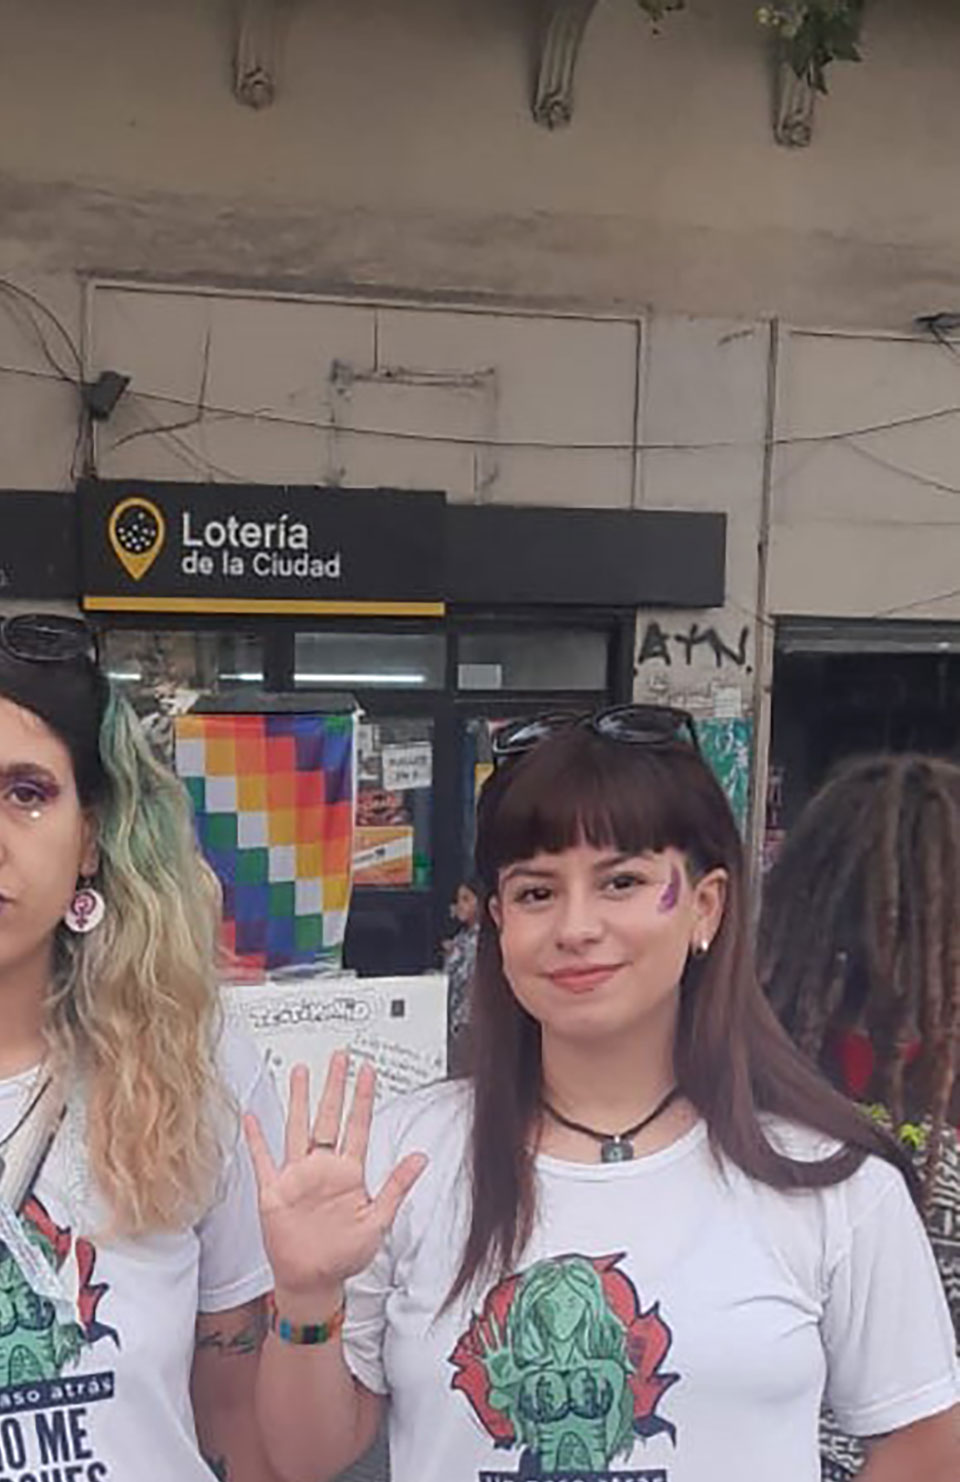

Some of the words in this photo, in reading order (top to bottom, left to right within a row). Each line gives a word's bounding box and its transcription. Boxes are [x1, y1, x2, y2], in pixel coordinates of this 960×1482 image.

[182, 512, 308, 549] Lotería
[182, 550, 214, 574] de
[223, 551, 244, 575] la
[252, 551, 340, 578] Ciudad
[35, 1407, 92, 1465] ME
